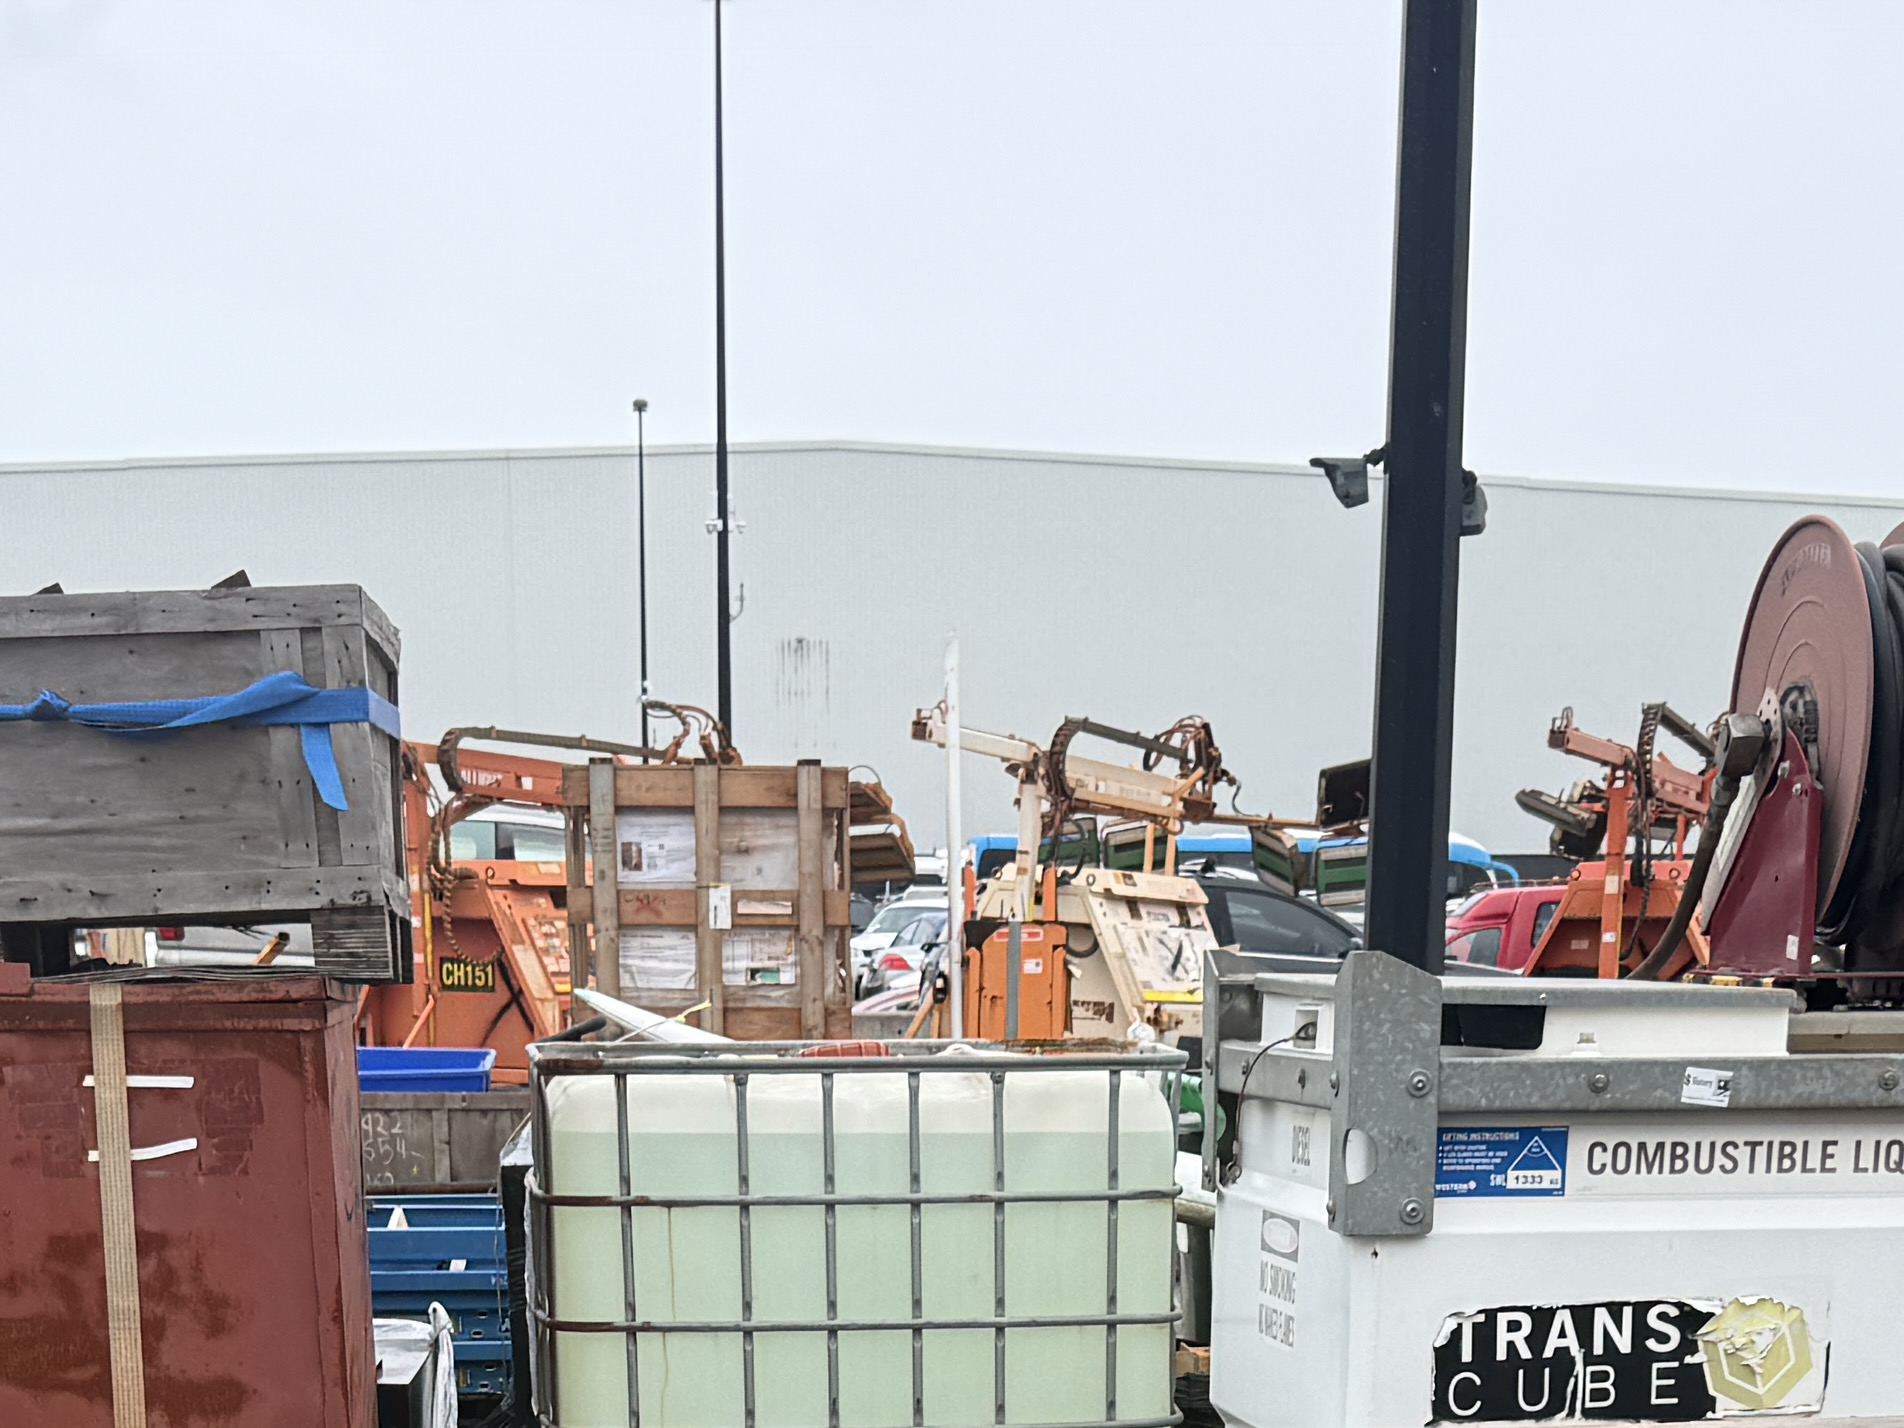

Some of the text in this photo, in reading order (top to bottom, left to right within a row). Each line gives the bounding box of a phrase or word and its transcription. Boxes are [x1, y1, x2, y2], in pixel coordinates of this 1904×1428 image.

[442, 963, 494, 988] CH151
[1586, 1139, 1839, 1176] COMBUSTIBLE
[1456, 1303, 1681, 1363] TRANS
[1447, 1361, 1681, 1417] CUBE
